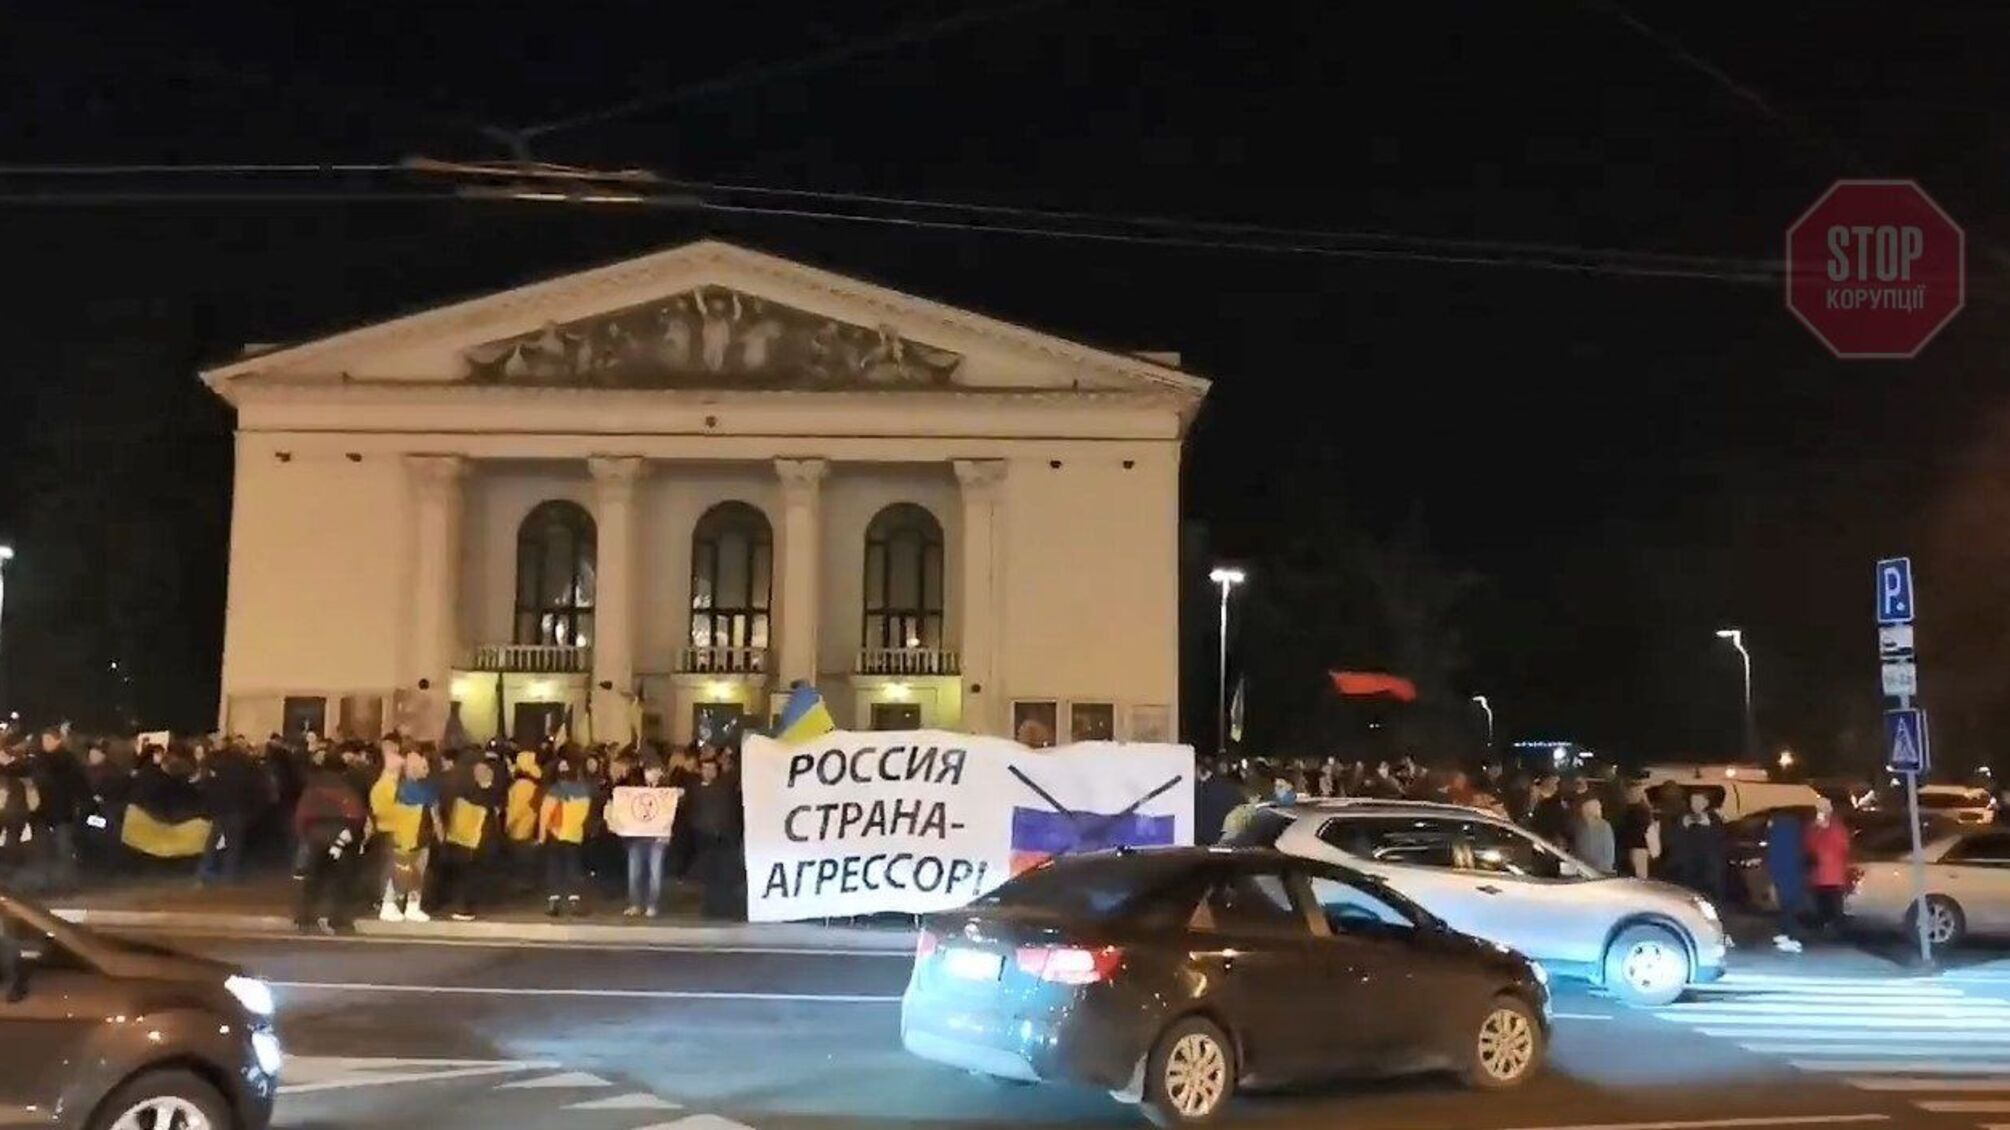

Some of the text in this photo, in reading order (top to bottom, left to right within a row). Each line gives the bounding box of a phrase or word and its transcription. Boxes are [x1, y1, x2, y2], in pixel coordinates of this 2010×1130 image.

[787, 746, 967, 787] РОССИЯ
[784, 798, 965, 842] СТРАНА-
[763, 852, 988, 897] АГРЕССОР!
